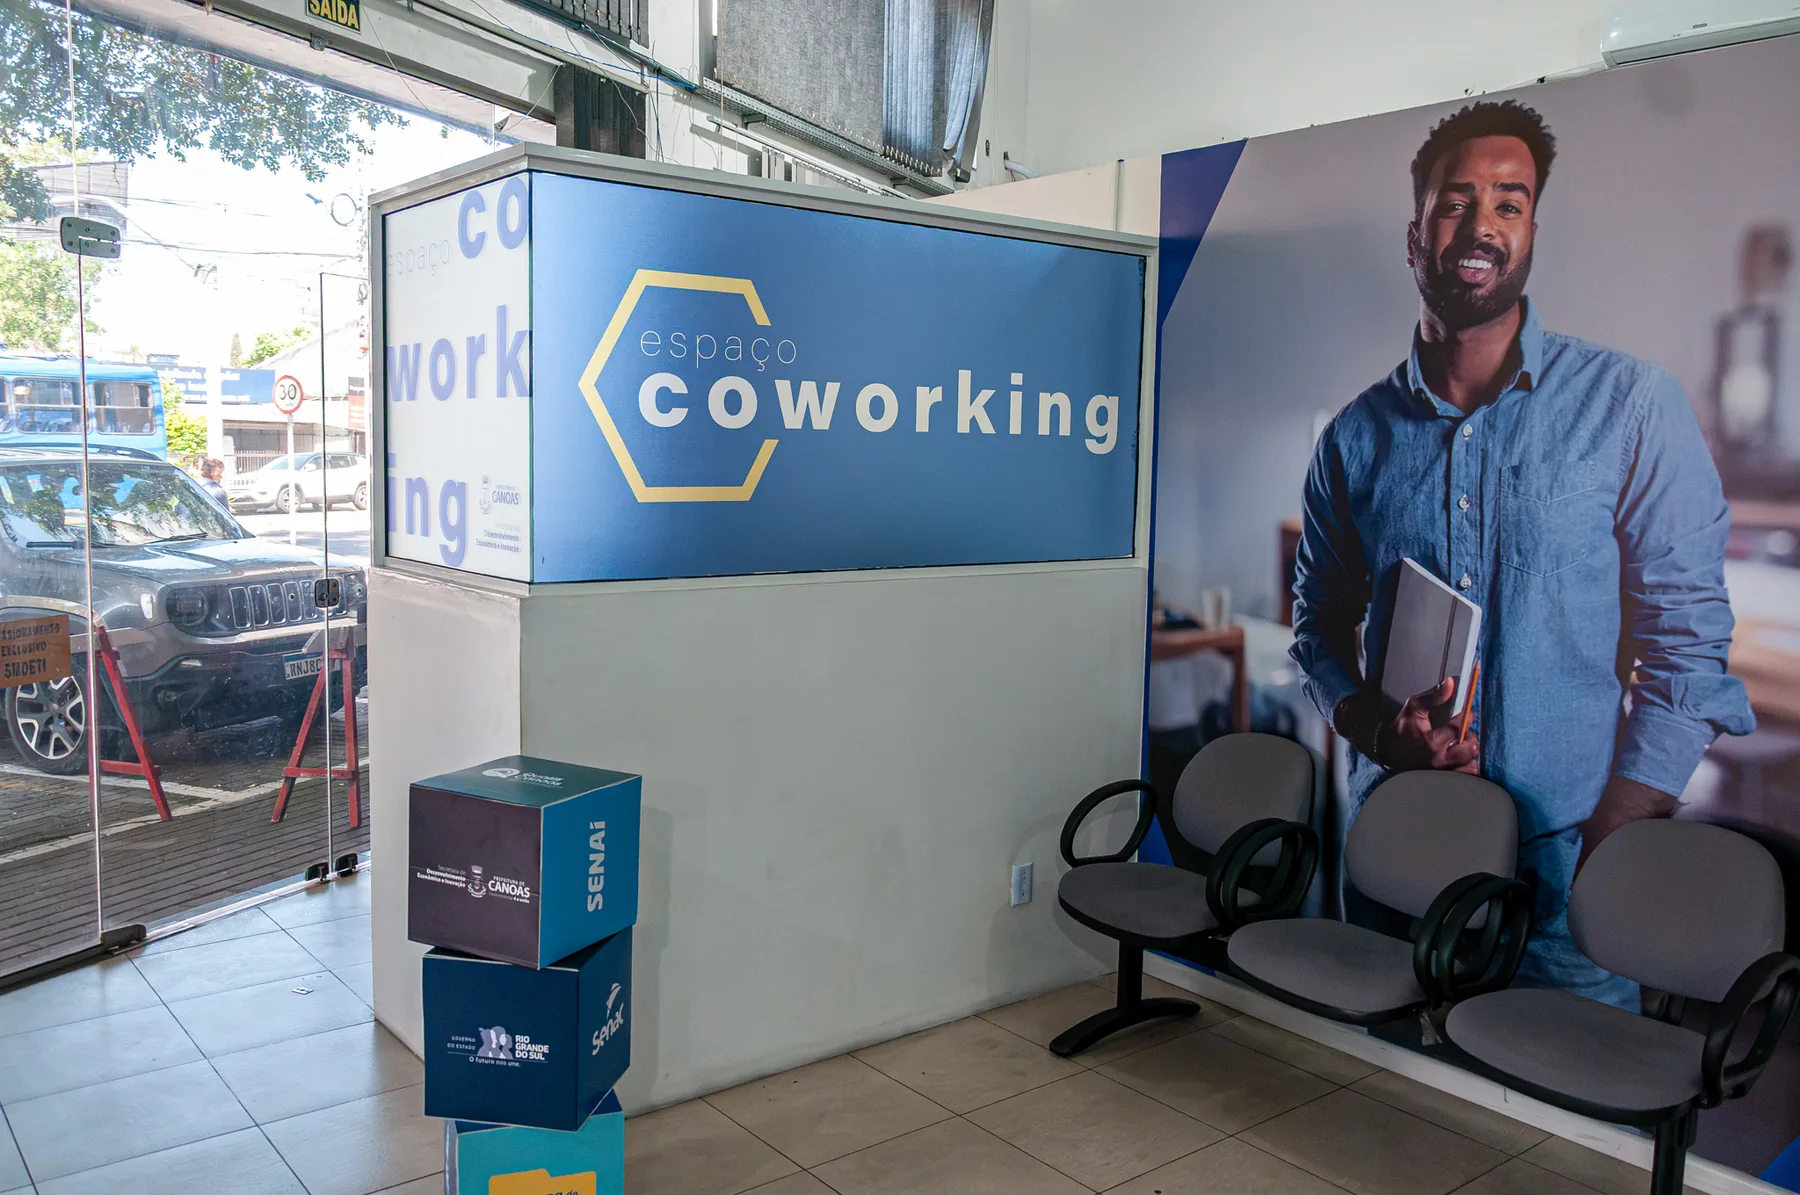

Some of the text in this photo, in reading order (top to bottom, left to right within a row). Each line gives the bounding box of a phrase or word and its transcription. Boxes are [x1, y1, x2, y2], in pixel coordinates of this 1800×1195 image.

[387, 304, 532, 402] work
[639, 329, 797, 372] espaço
[279, 384, 297, 400] 30
[638, 369, 1120, 455] coworking
[492, 490, 520, 505] CANOAS
[388, 453, 468, 567] ing
[290, 658, 322, 677] RNJ8C
[493, 875, 518, 886] PREFEITURA
[488, 880, 530, 898] CANOAS
[451, 1035, 476, 1043] GOVERNO
[515, 1034, 530, 1044] RIO
[456, 1043, 476, 1051] ESTADO
[515, 1042, 549, 1053] GRANDE
[475, 1056, 495, 1065] futuro
[515, 1050, 545, 1060] DO SUL
